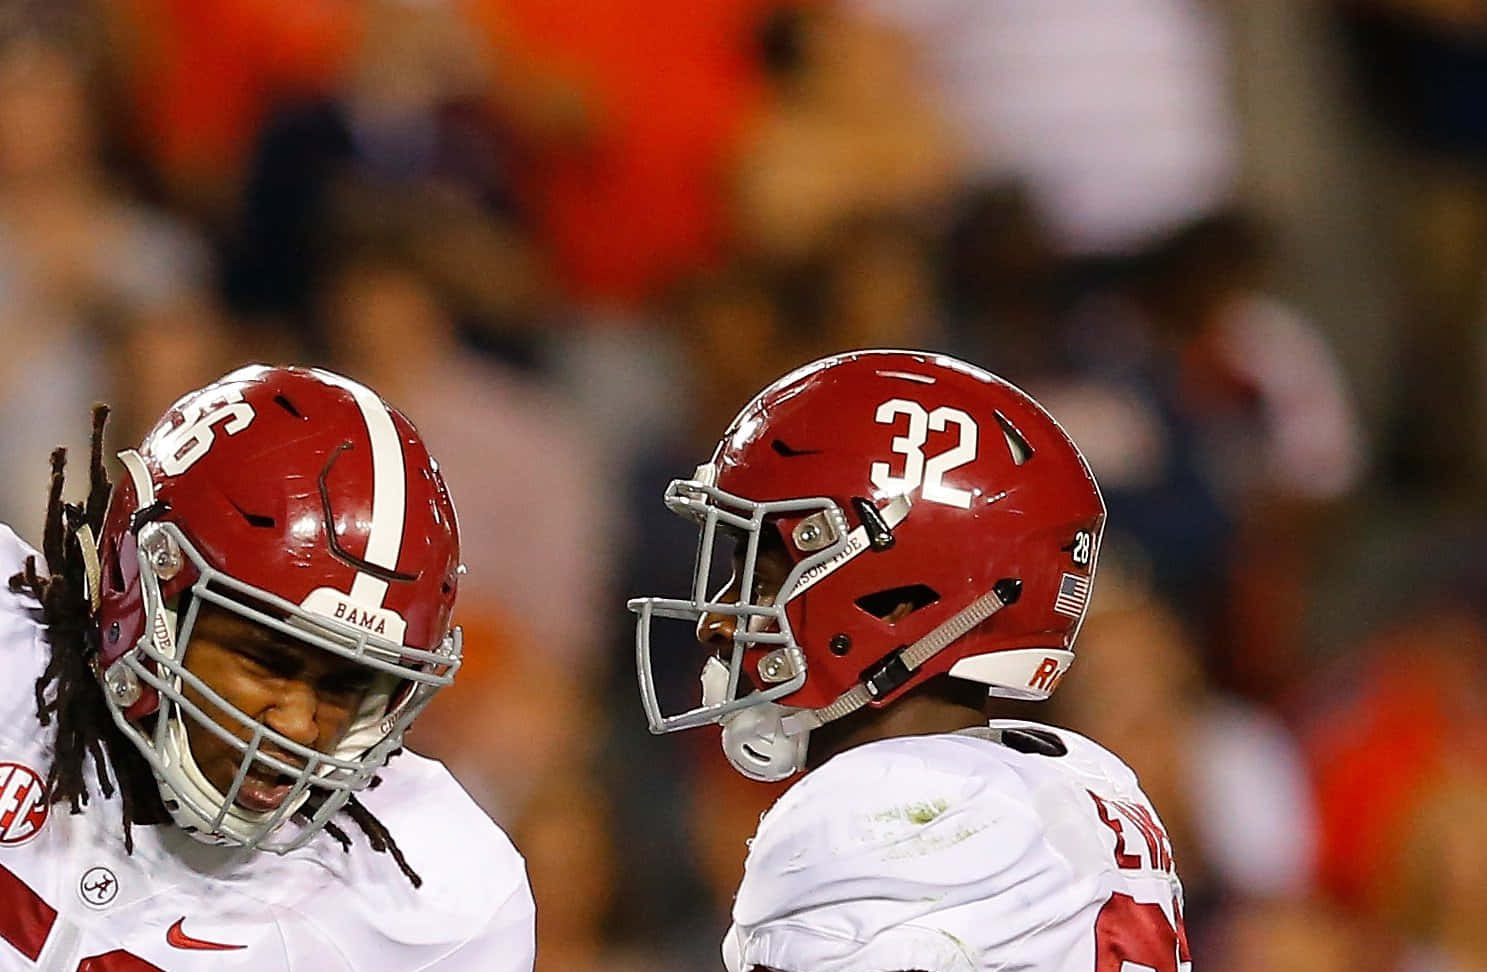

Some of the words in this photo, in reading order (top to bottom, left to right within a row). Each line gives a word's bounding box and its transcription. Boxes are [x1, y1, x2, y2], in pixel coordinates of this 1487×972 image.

[149, 383, 256, 477] 56
[870, 398, 978, 509] 32
[1073, 531, 1090, 564] 28
[153, 613, 172, 650] TIDE
[333, 602, 386, 635] BAMA
